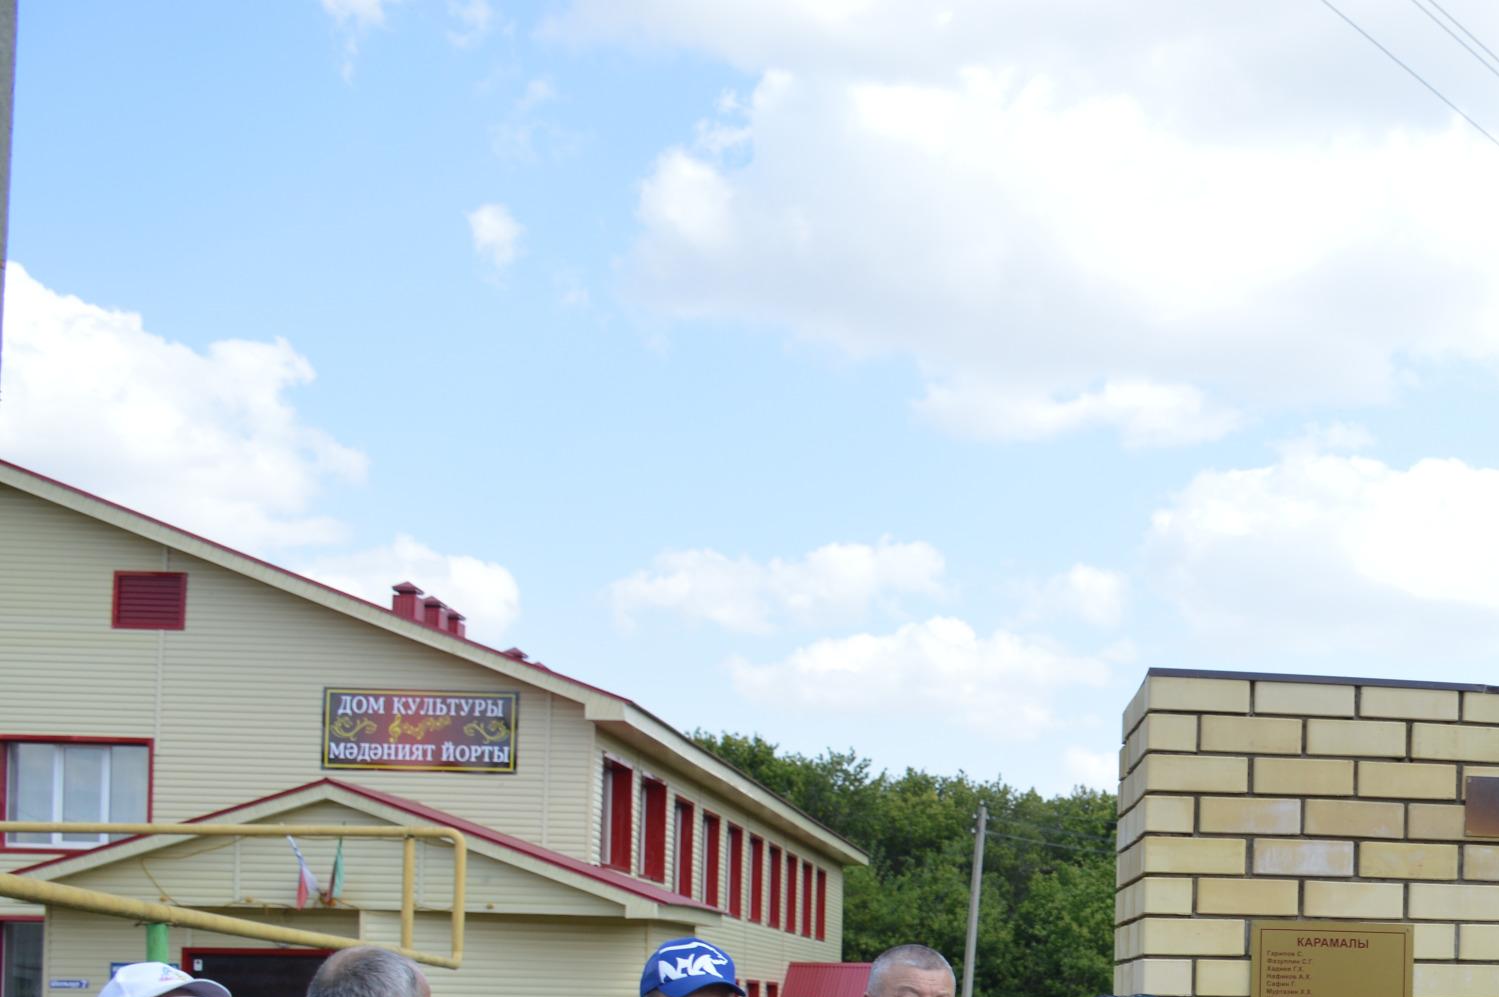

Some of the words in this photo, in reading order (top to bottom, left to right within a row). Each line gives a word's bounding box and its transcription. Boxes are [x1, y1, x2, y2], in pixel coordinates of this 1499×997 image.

[337, 695, 385, 715] ДОМ
[392, 696, 504, 718] КУЛЬТУРЫ
[329, 741, 436, 763] МӘДӘНИЯТ
[441, 740, 510, 764] ЙОРТЫ
[1296, 937, 1369, 949] КАРАМАЛЫ
